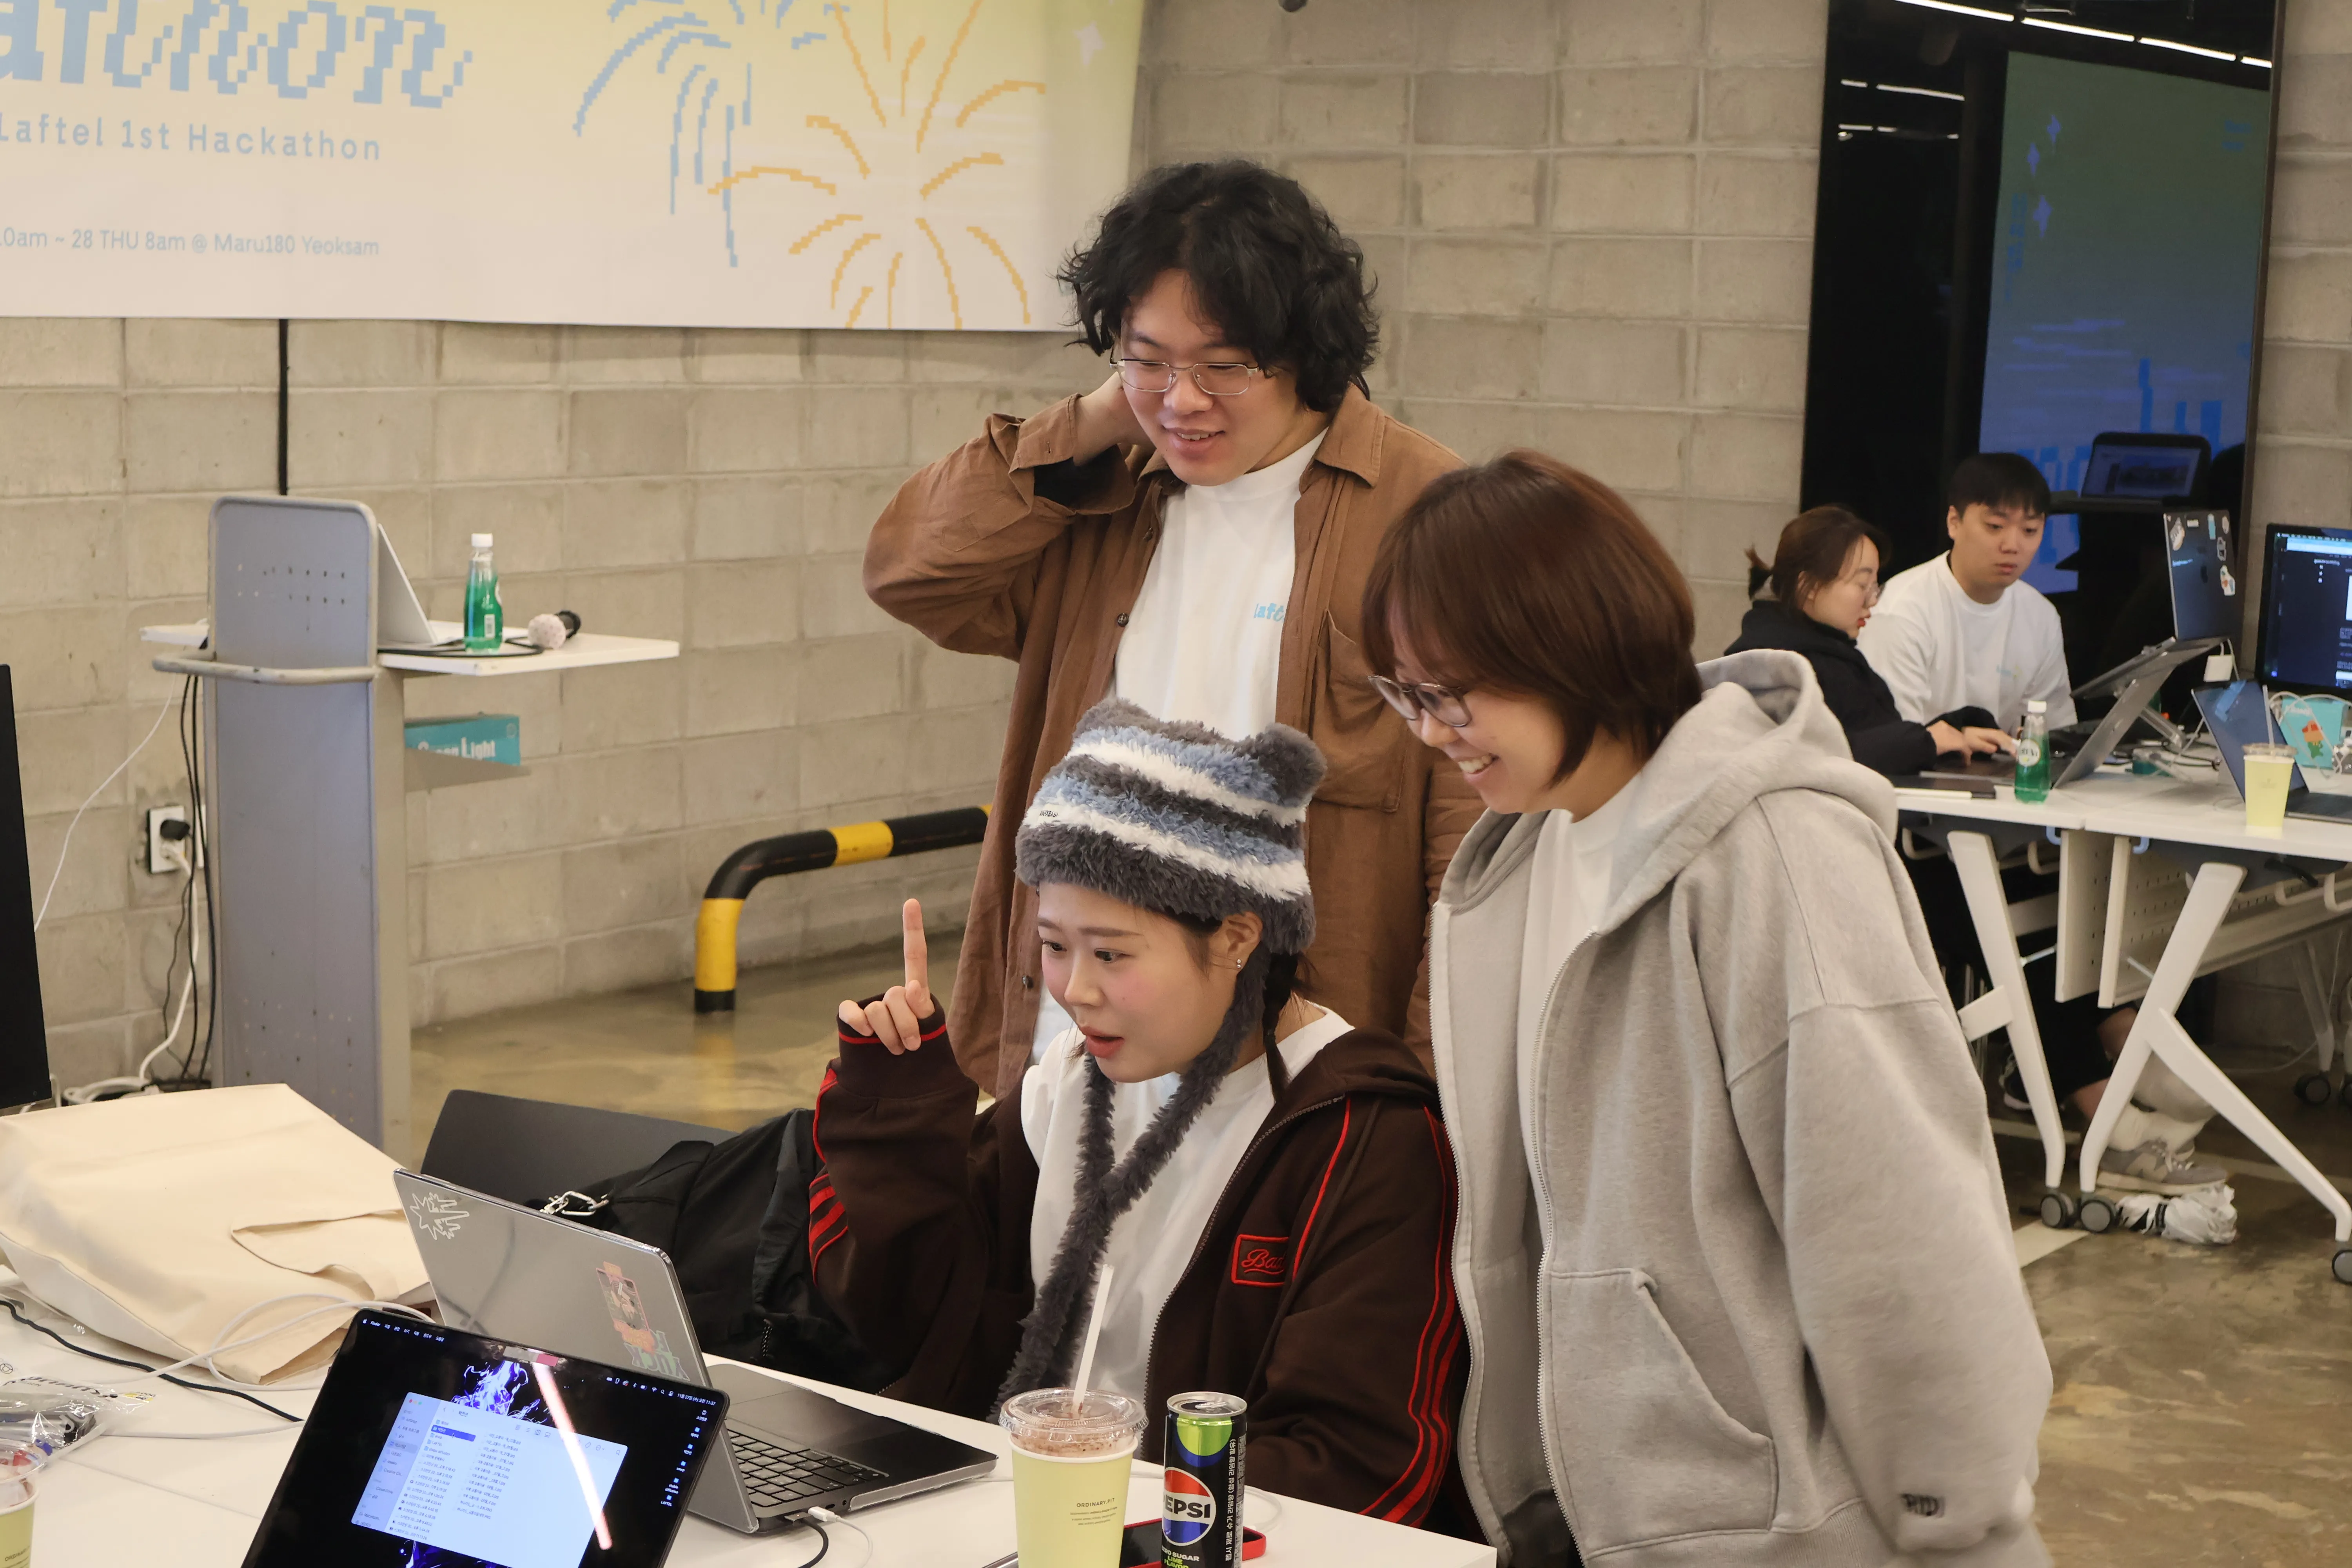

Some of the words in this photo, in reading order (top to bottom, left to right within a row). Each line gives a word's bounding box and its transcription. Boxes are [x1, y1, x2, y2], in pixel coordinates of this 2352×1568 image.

[0, 112, 103, 147] Laftel
[122, 120, 169, 150] 1st
[189, 123, 379, 160] Hackathon
[0, 227, 47, 248] 0am
[72, 229, 93, 249] 28
[100, 230, 139, 250] THU
[145, 230, 185, 250] 8am
[192, 233, 208, 254] @
[214, 233, 296, 254] Maru180
[301, 235, 379, 256] Yeoksam
[1163, 1495, 1210, 1518] EPSI
[1227, 1515, 1233, 1529] 슈거
[1226, 1530, 1232, 1545] 제로
[1167, 1555, 1183, 1564] LIME
[1172, 1552, 1200, 1562] SUGAR
[1225, 1546, 1232, 1561] 펩시
